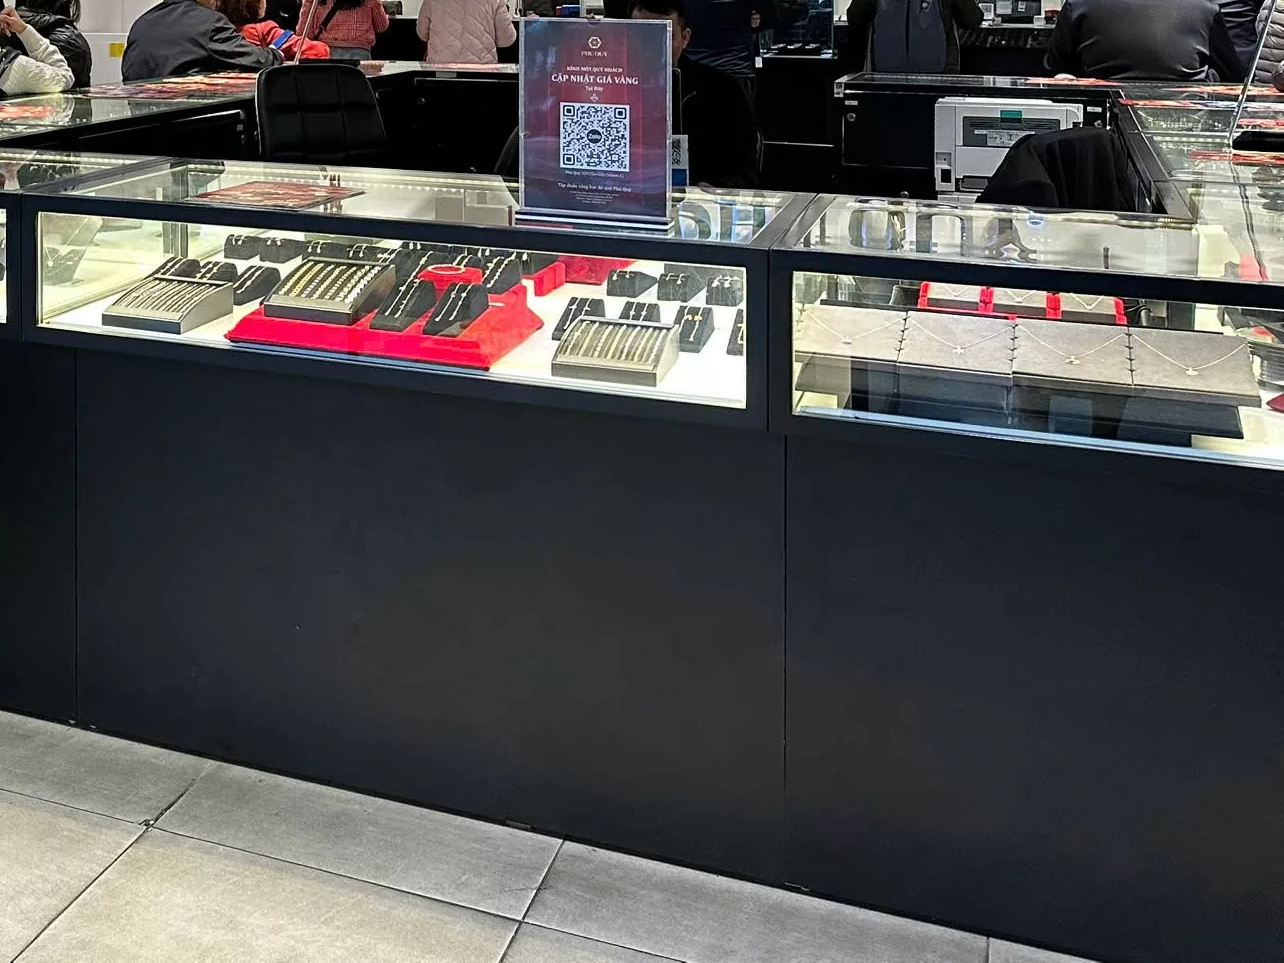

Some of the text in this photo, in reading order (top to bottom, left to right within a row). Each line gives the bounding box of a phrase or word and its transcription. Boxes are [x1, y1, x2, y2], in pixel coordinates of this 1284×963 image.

[551, 72, 639, 85] CẬP NHẬT GIÁ VÀNG
